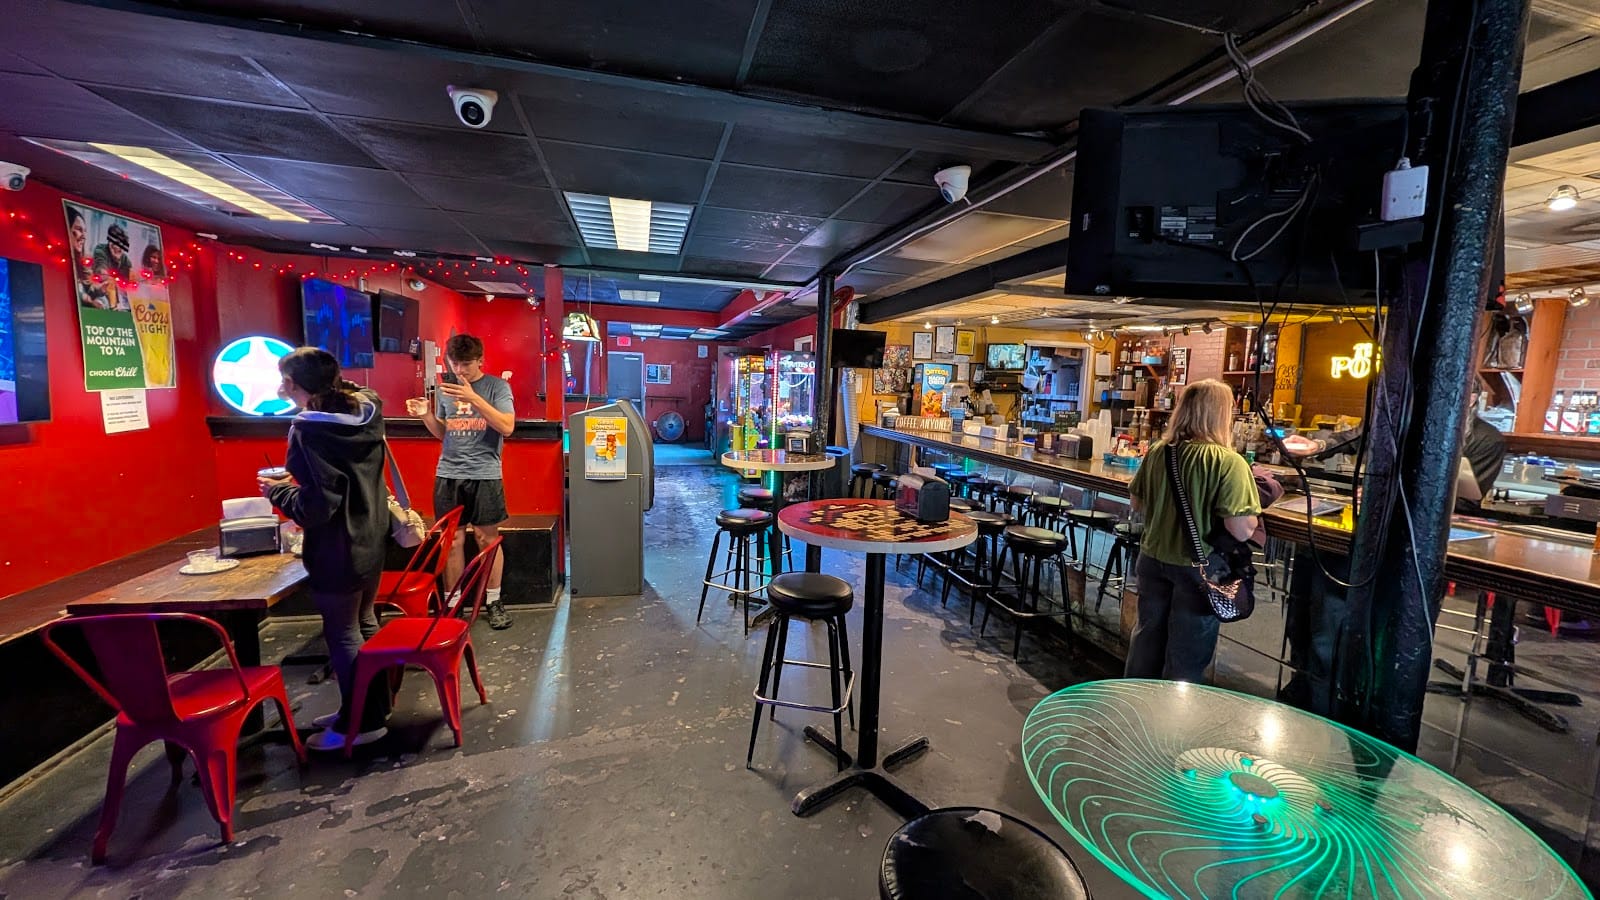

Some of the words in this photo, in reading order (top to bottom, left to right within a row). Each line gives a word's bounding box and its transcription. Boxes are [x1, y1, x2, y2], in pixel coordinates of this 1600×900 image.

[133, 304, 169, 325] Coors
[85, 325, 105, 336] TOP
[117, 328, 134, 338] THE
[141, 323, 168, 335] LIGHT
[86, 336, 136, 347] MOUNTAIN
[100, 346, 114, 356] TO
[114, 347, 126, 356] YA
[115, 367, 138, 378] Chill
[919, 417, 952, 431] ANYONE?
